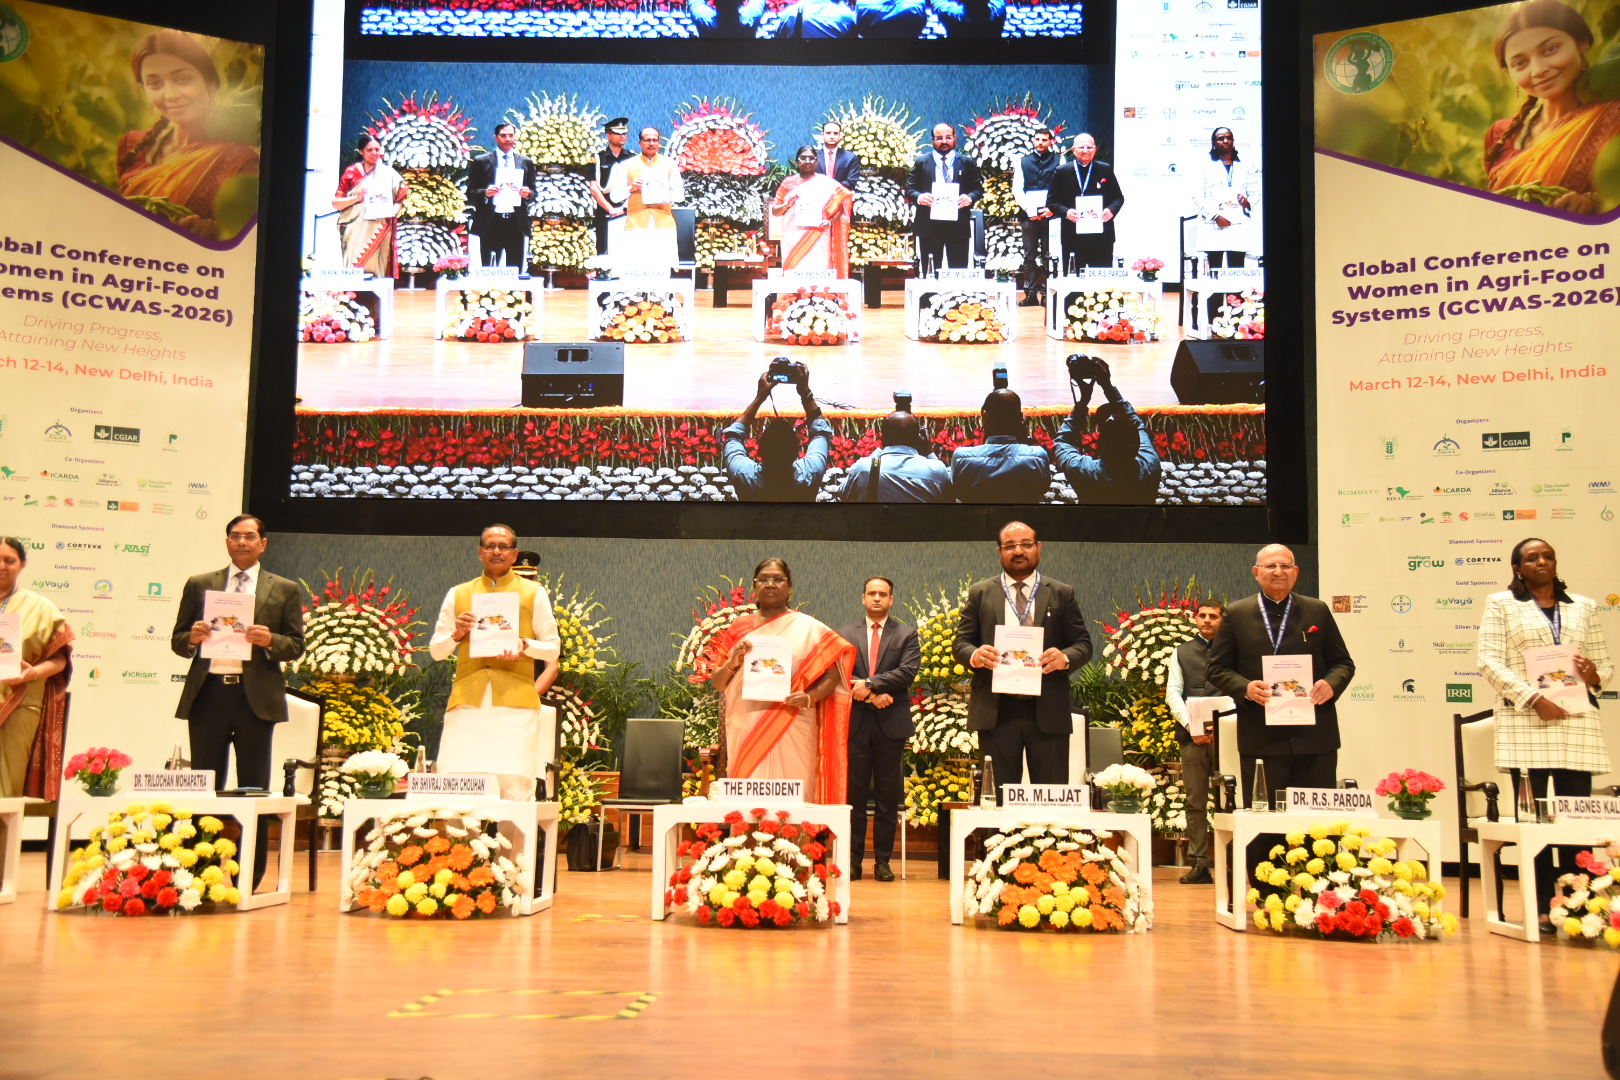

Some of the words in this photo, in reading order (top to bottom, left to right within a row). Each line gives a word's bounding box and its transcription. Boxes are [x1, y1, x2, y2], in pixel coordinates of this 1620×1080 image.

[0, 236, 42, 256] bal
[50, 243, 190, 275] Conference
[196, 265, 225, 279] on
[1342, 257, 1416, 278] Global
[1424, 246, 1569, 271] Conference
[1577, 242, 1610, 255] on
[72, 267, 94, 285] in
[102, 273, 220, 301] Agri-Food
[1347, 281, 1439, 301] Women
[1446, 276, 1469, 293] in
[1476, 264, 1605, 292] Agri-Food
[0, 287, 54, 304] ems
[62, 290, 233, 327] (GCWAS-2026)
[1332, 303, 1431, 327] Systems
[1438, 287, 1620, 320] (GCWAS-2026)
[23, 314, 85, 335] Driving
[89, 322, 163, 342] Progress,
[1403, 330, 1463, 346] Driving
[1468, 325, 1545, 342] Progress,
[81, 338, 119, 355] New
[123, 343, 187, 361] Heights
[1378, 347, 1456, 364] Attaining
[1461, 346, 1500, 360] New
[1504, 340, 1573, 357] Heights
[22, 357, 69, 376] 12-14,
[75, 363, 114, 378] New
[119, 368, 167, 385] Delhi,
[172, 373, 214, 388] India
[1349, 377, 1401, 392] March
[1406, 375, 1451, 389] 12-14,
[1456, 371, 1496, 386] New
[1502, 367, 1554, 383] Delhi,
[1560, 364, 1607, 379] India
[114, 433, 139, 442] CGIAR
[1502, 438, 1528, 447] CGIAR
[50, 472, 79, 480] ICARDA
[1443, 486, 1471, 494] ICARDA
[51, 523, 77, 531] Diamond
[1476, 538, 1502, 546] Sponsors
[1408, 559, 1444, 571] grow
[88, 631, 117, 639] CRYSTAL
[1446, 689, 1471, 698] IRRI
[134, 774, 142, 787] DR.
[144, 774, 174, 788] TRILOCHAN
[176, 774, 207, 788] MOHAPATRA
[724, 781, 743, 796] THE
[746, 782, 800, 796] PRESIDENT
[1008, 788, 1028, 802] DR.
[1034, 788, 1082, 802] M.L.JAT
[1293, 792, 1308, 806] DR.
[1312, 792, 1330, 806] R.S.
[1334, 793, 1372, 808] PARODA
[1558, 799, 1572, 813] DR.
[1574, 800, 1602, 813] AGNES
